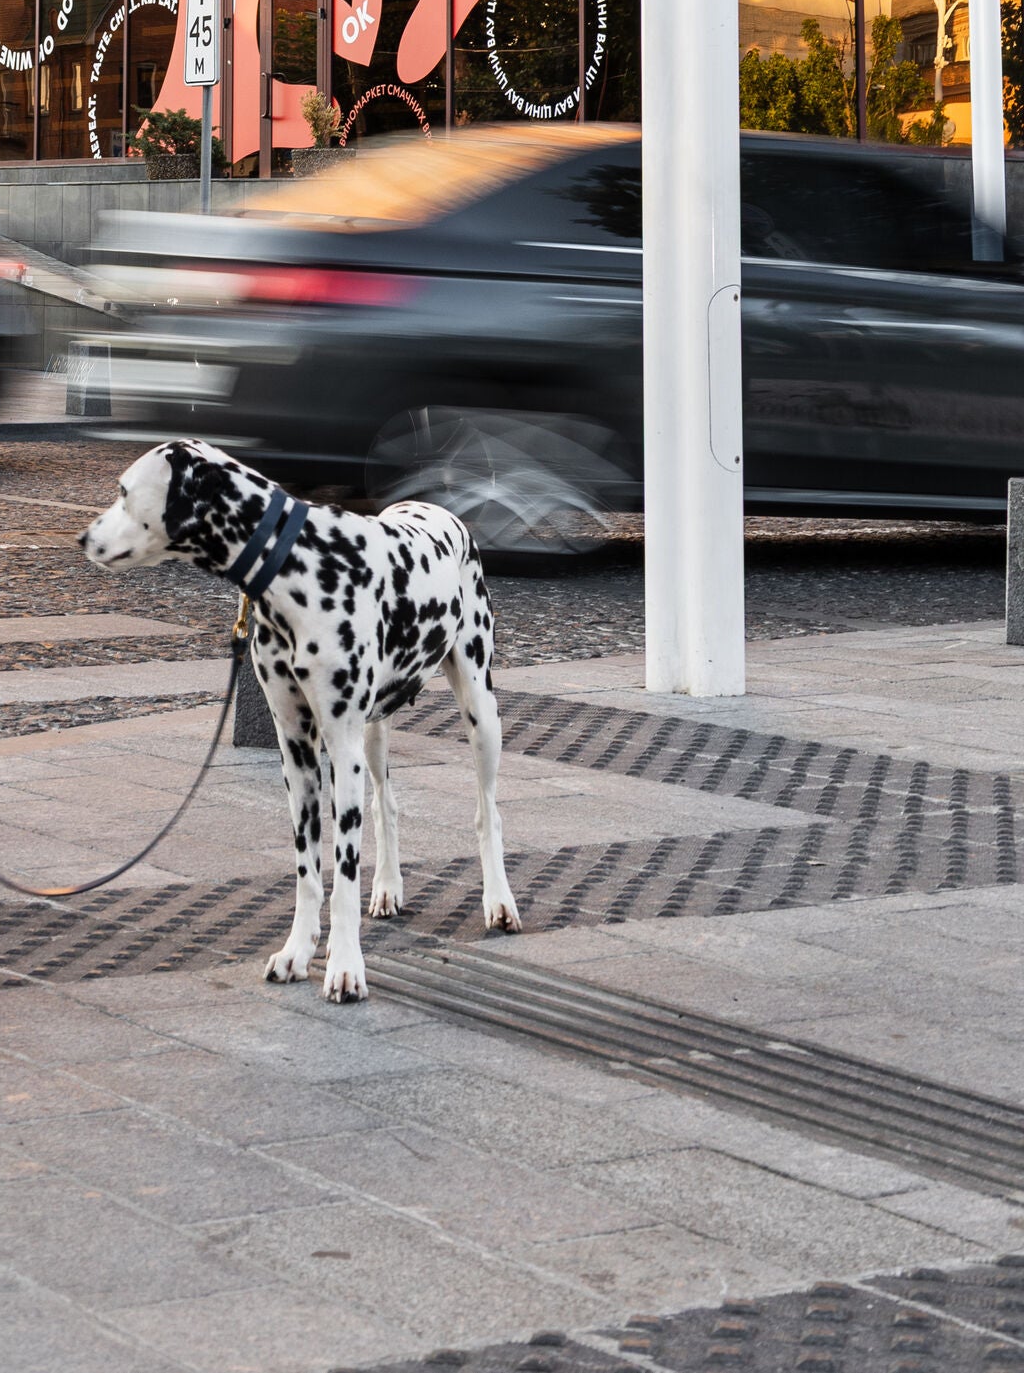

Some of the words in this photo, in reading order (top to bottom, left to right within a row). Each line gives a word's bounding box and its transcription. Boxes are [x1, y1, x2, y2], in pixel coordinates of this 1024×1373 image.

[189, 15, 212, 48] 45
[486, 16, 496, 48] ВАУ
[90, 31, 113, 83] TASTE.
[593, 33, 607, 67] ВАУ
[488, 50, 508, 90] ЦІНИ
[339, 84, 386, 147] ВИНОМАРКЕТ
[387, 84, 427, 124] СМАЧНИХ
[504, 87, 525, 111] ВАУ
[524, 101, 553, 119] ЦІНИ
[554, 94, 574, 118] ВАУ
